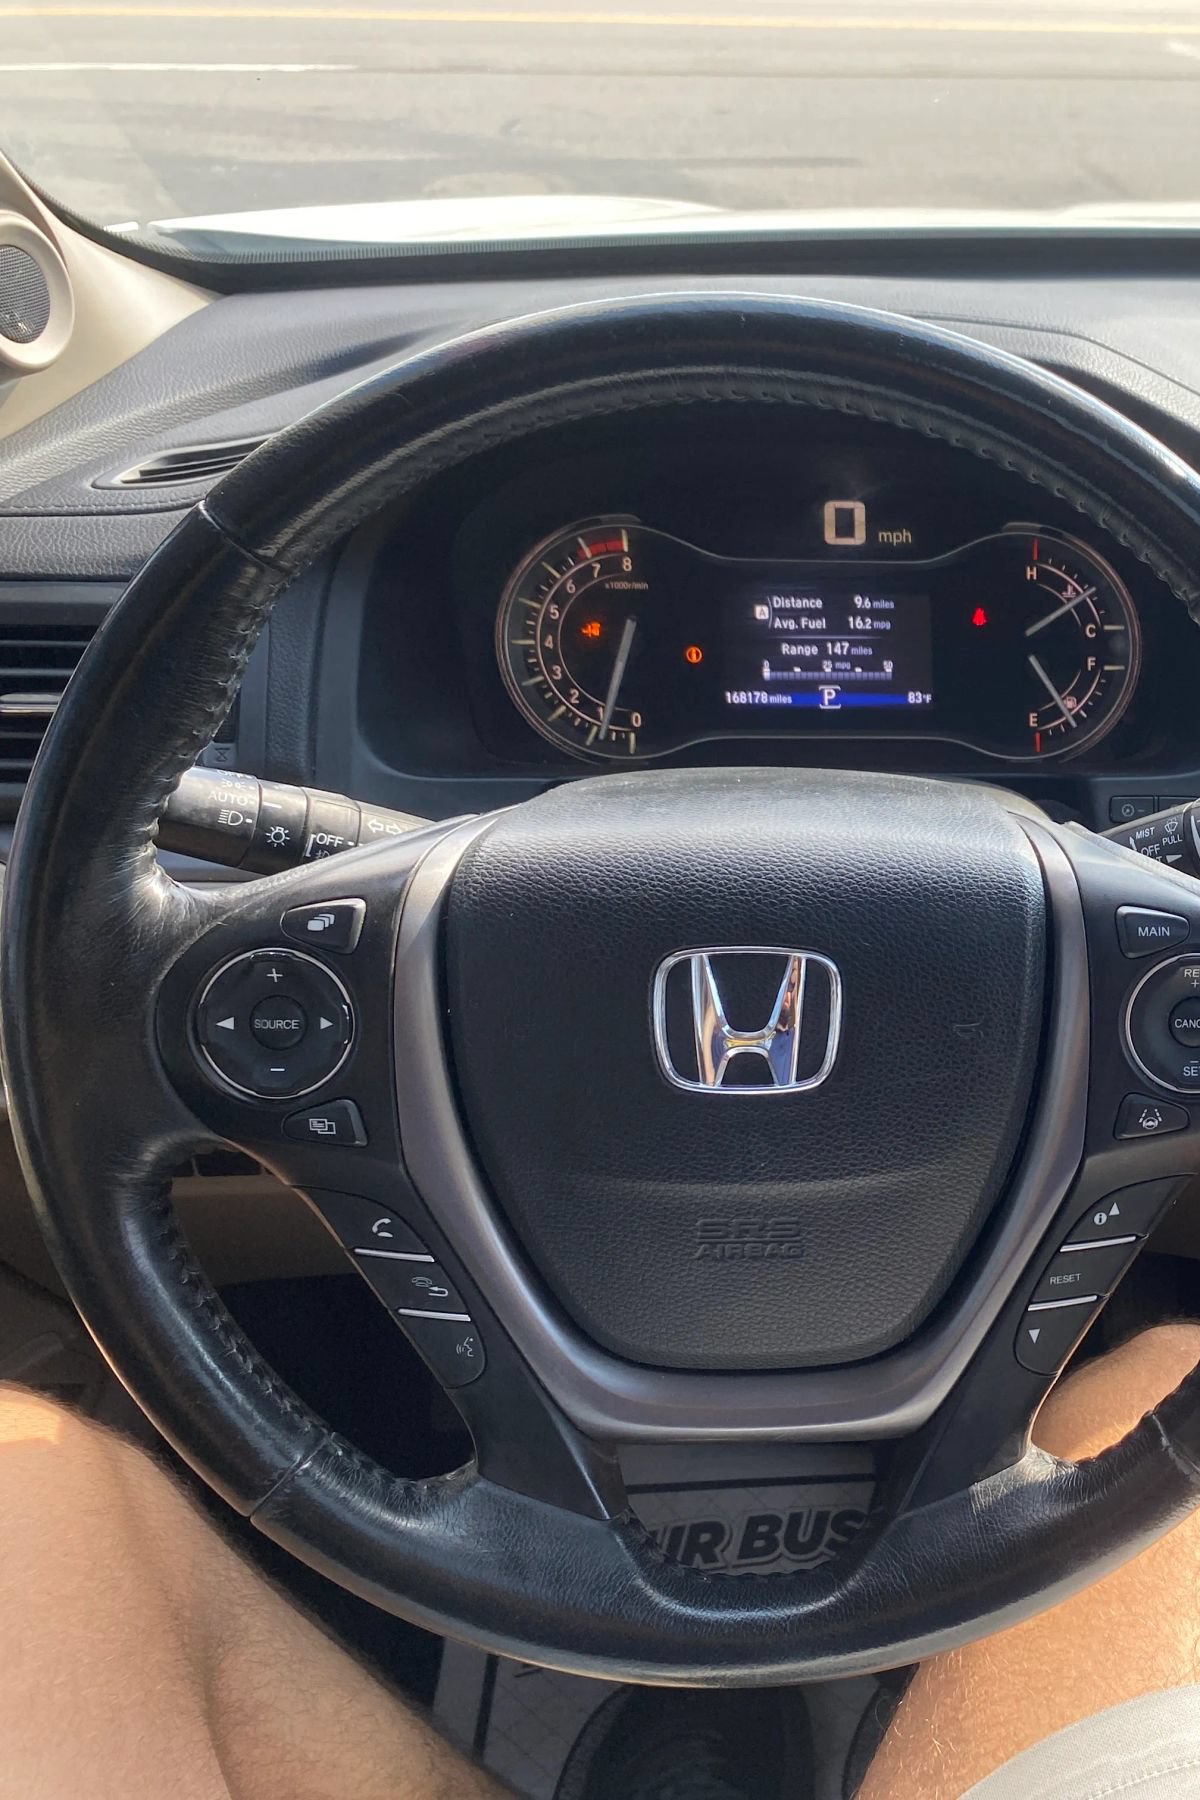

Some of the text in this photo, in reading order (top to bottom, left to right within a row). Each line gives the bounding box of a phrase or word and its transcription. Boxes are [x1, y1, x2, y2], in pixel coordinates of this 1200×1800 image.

[824, 500, 912, 546] 0 mph
[591, 563, 600, 578] 7
[622, 556, 632, 572] 8
[1026, 566, 1037, 580] H
[566, 579, 576, 594] 6
[773, 594, 895, 609] Distance 9.6 miles
[550, 605, 560, 620] 5
[774, 616, 892, 630] Avg. Fuel 16.2 mpg
[1085, 624, 1096, 638] C
[544, 634, 554, 649] 4
[781, 642, 873, 656] Range 147 miles
[763, 660, 770, 670] 0
[822, 660, 832, 670] 25
[834, 661, 851, 670] mpg
[1087, 656, 1096, 671] F
[552, 665, 562, 680] 3
[570, 688, 580, 704] 2
[725, 691, 768, 704] 168178
[769, 694, 792, 704] miles
[823, 688, 836, 706] P
[631, 712, 642, 728] 0
[1029, 713, 1038, 727] E
[208, 791, 248, 806] AUTO
[315, 832, 344, 848] OFF
[1136, 826, 1155, 840] MIST
[1162, 834, 1183, 846] PULL
[1140, 844, 1160, 857] OFF
[1138, 926, 1170, 937] MAIN
[254, 1019, 300, 1030] SOURCE
[697, 1218, 800, 1237] SRS
[693, 1244, 805, 1260] AIRBAG
[1050, 1273, 1082, 1285] RESET
[650, 1509, 868, 1567] IR BUS
